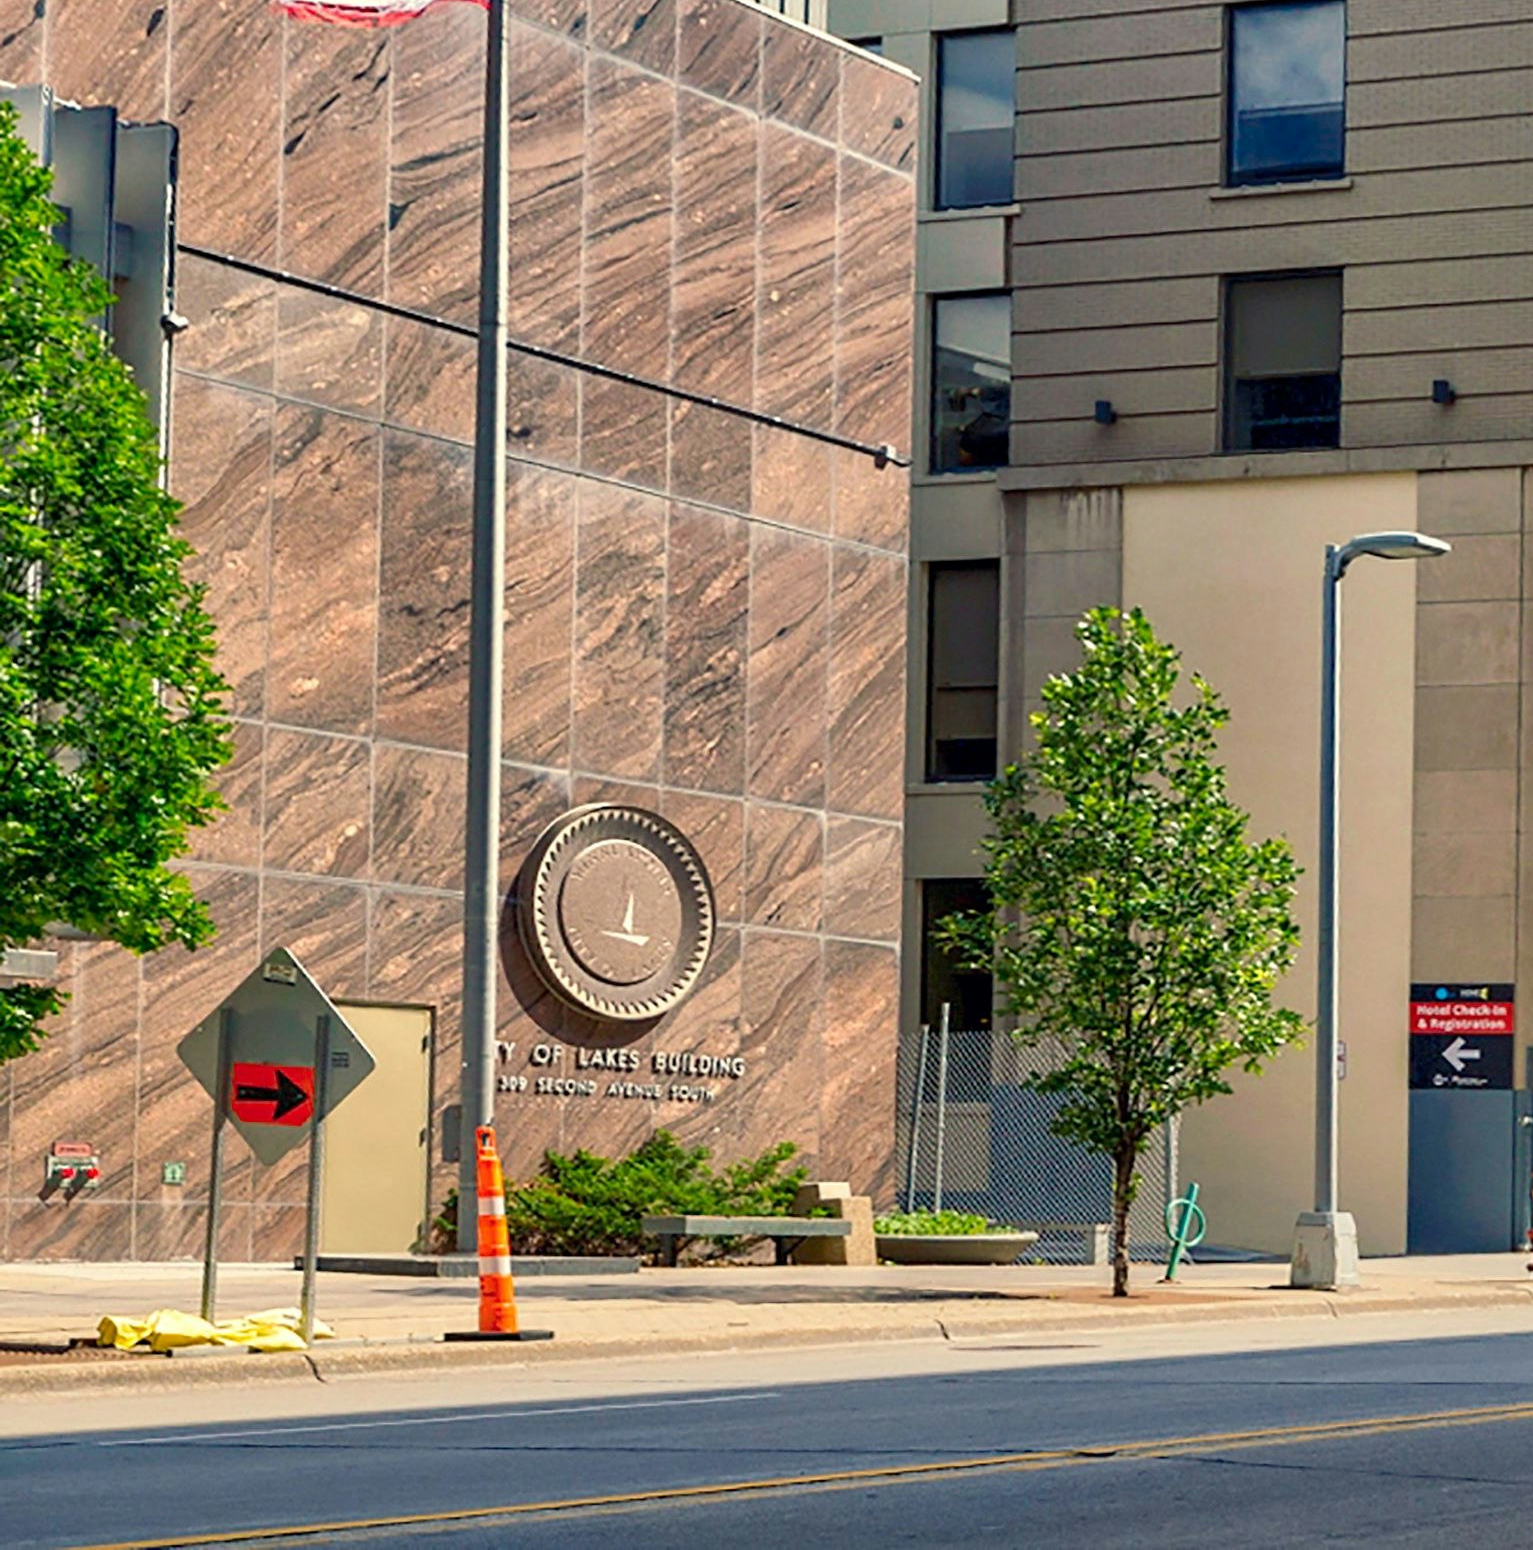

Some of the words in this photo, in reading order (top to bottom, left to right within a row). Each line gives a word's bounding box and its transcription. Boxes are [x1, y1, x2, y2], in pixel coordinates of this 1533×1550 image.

[1416, 1004, 1451, 1016] Hotel
[1430, 1018, 1506, 1032] Registration
[532, 1044, 562, 1064] OF
[579, 1047, 640, 1069] LAKES
[655, 1052, 746, 1076] BUILDING
[500, 1075, 528, 1092] 309
[537, 1076, 597, 1095] SECOND
[608, 1082, 662, 1098] AVENUE
[671, 1085, 716, 1101] SOUTH
